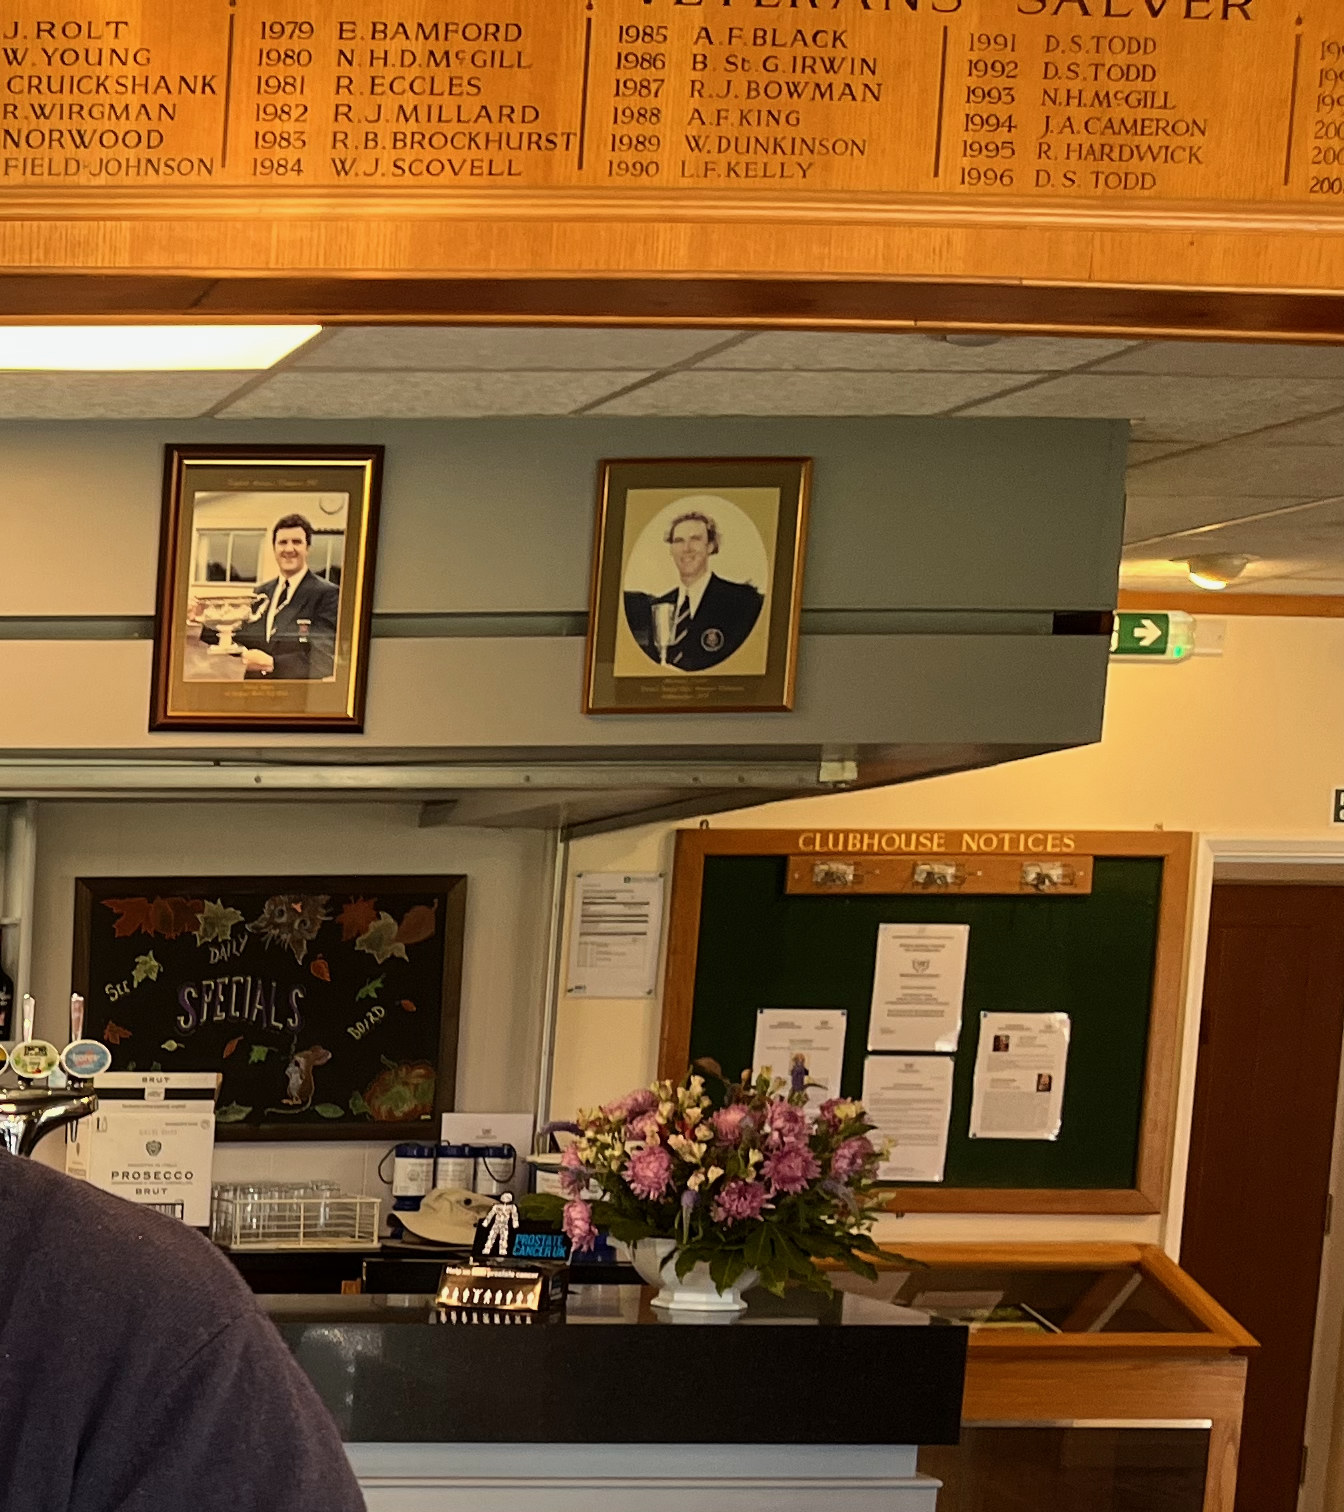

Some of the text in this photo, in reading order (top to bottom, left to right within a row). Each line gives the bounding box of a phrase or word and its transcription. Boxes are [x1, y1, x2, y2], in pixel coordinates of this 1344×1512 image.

[260, 20, 314, 39] 1979
[618, 25, 668, 44] 1985
[968, 34, 1016, 52] 1991
[258, 48, 312, 67] 1980
[616, 52, 666, 70] 1986
[967, 60, 1019, 79] 1992
[256, 75, 305, 95] 1981
[614, 79, 665, 98] 1987
[965, 86, 1015, 105] 1993
[256, 103, 308, 122] 1982
[613, 107, 661, 125] 1988
[964, 114, 1017, 132] 1994
[255, 131, 306, 149] 1983
[610, 133, 661, 152] 1989
[963, 140, 1015, 159] 1995
[252, 156, 304, 175] 1984
[608, 160, 660, 178] 1990
[960, 168, 1014, 187] 1996
[798, 832, 1075, 851] CLUBHOUSE NOTICES
[210, 933, 248, 964] DAILY
[177, 976, 305, 1031] SPECIALS
[111, 1171, 194, 1180] PROSECCO
[135, 1187, 168, 1195] BRUT
[513, 1245, 551, 1257] CANCER
[515, 1233, 563, 1250] PROSTATE
